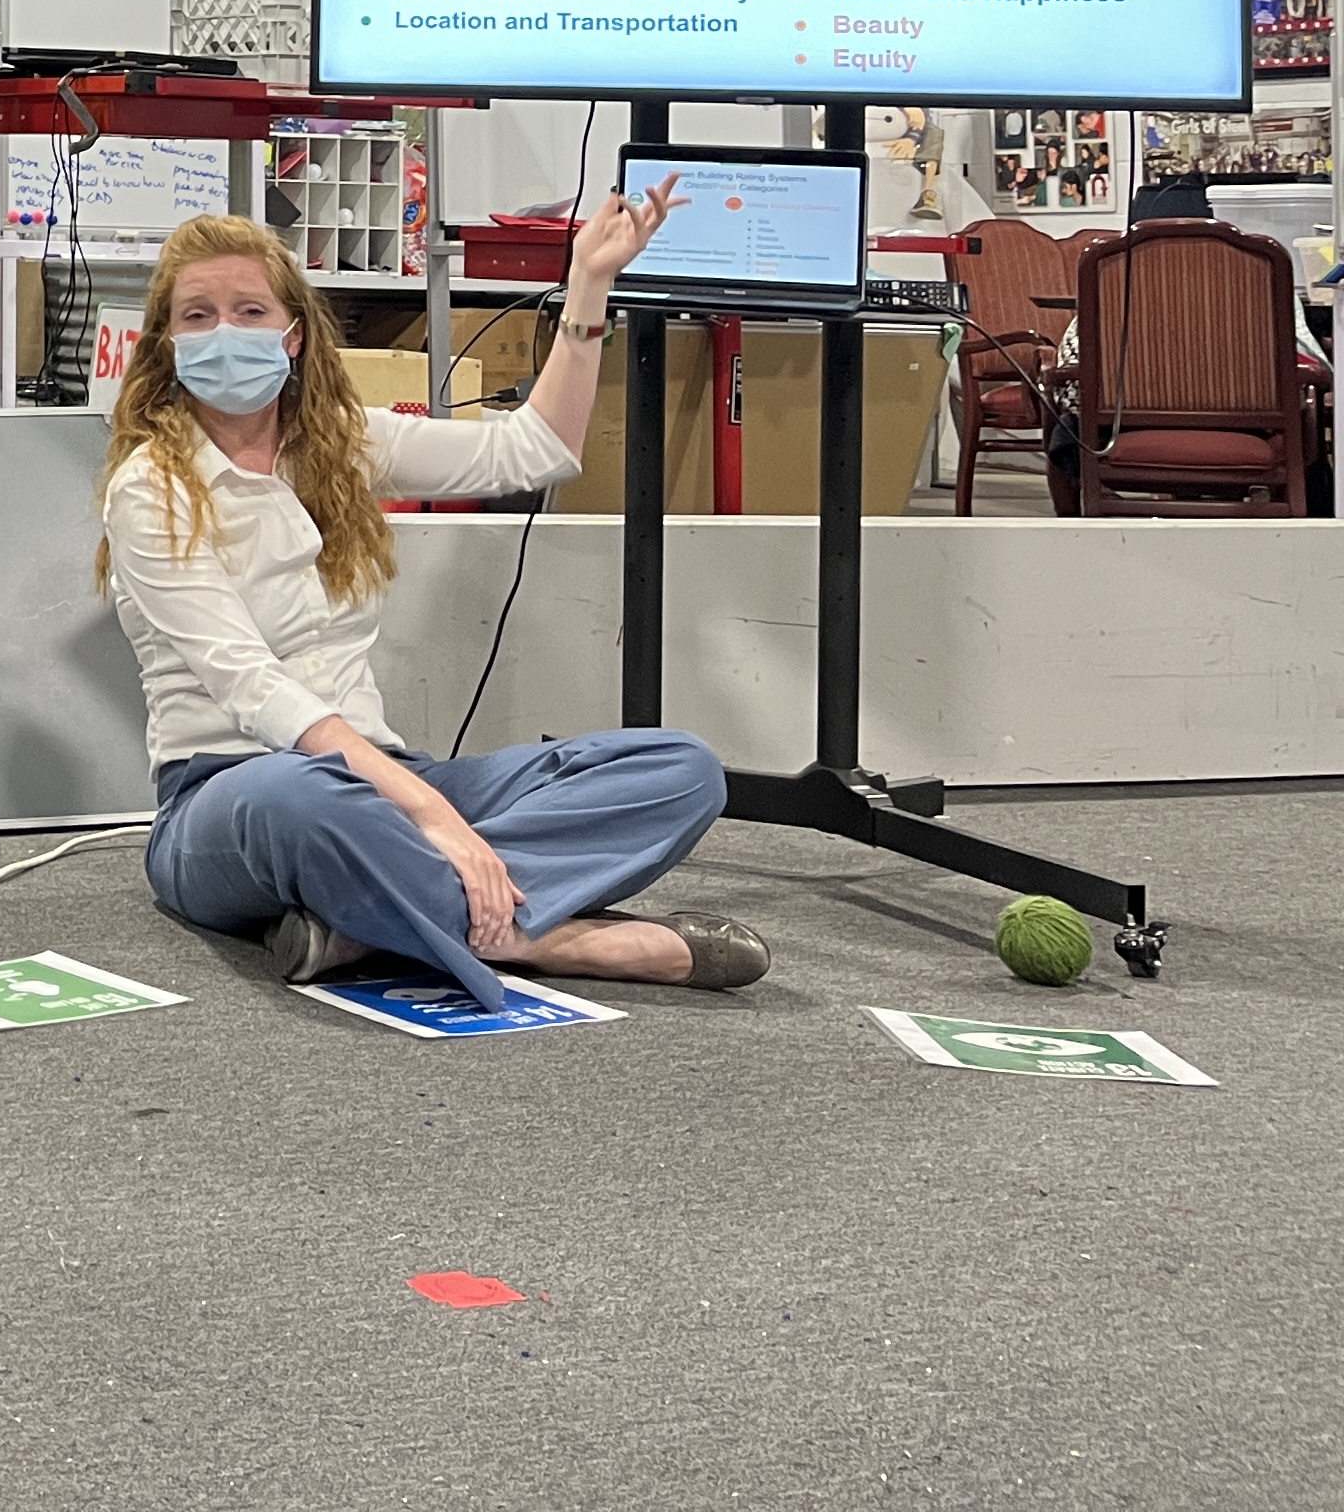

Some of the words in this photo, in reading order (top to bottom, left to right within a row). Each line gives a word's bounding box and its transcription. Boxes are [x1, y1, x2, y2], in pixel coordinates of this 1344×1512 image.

[396, 11, 496, 29] Location
[505, 13, 548, 30] and
[557, 13, 737, 35] Transportation
[833, 15, 924, 39] Beauty
[833, 49, 917, 73] Equity
[1170, 118, 1200, 134] Girls
[1202, 117, 1217, 134] of
